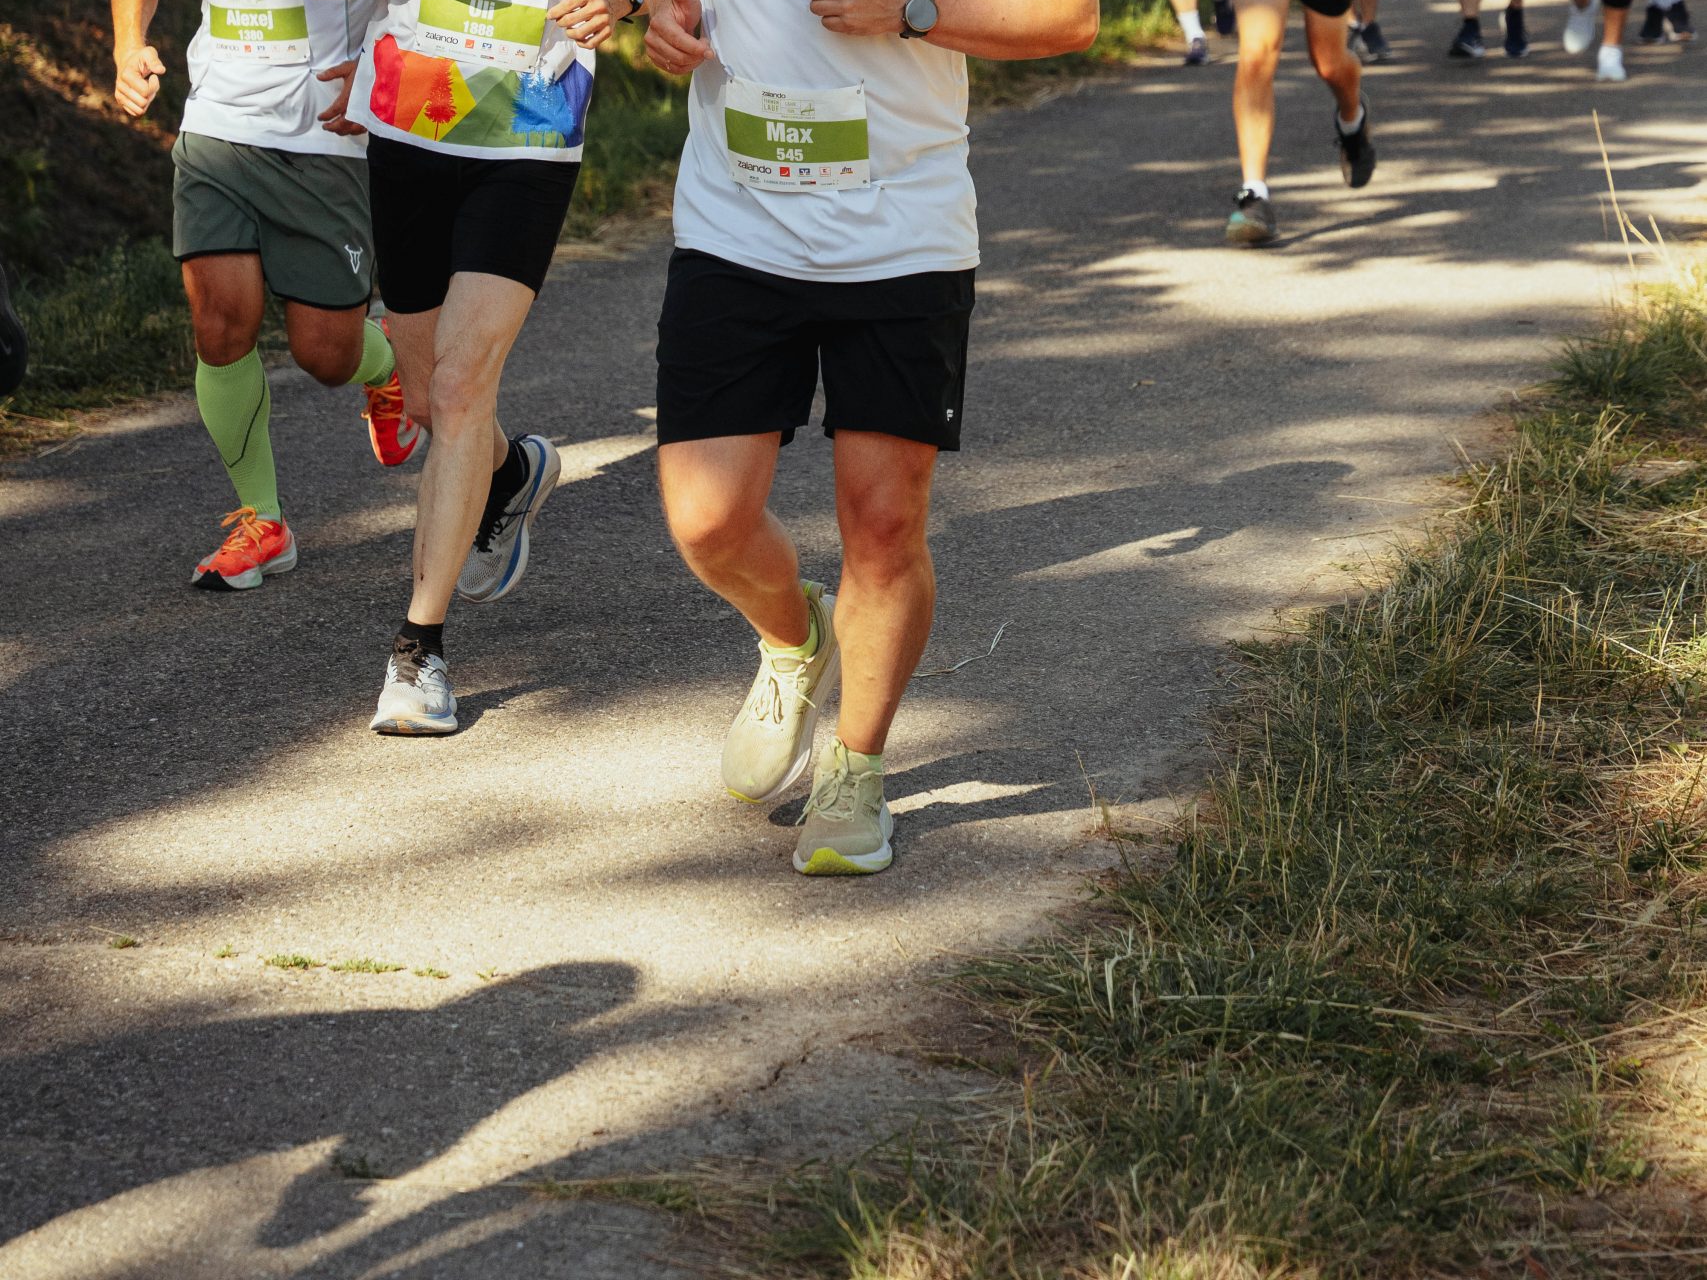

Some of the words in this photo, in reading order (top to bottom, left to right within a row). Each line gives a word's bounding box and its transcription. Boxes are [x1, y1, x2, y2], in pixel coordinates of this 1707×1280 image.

[226, 9, 274, 30] Alexej
[463, 20, 495, 37] 1888
[425, 31, 459, 45] zalando
[761, 90, 786, 99] zalando
[766, 121, 814, 144] Max
[776, 148, 804, 162] 545
[737, 160, 772, 175] zalando
